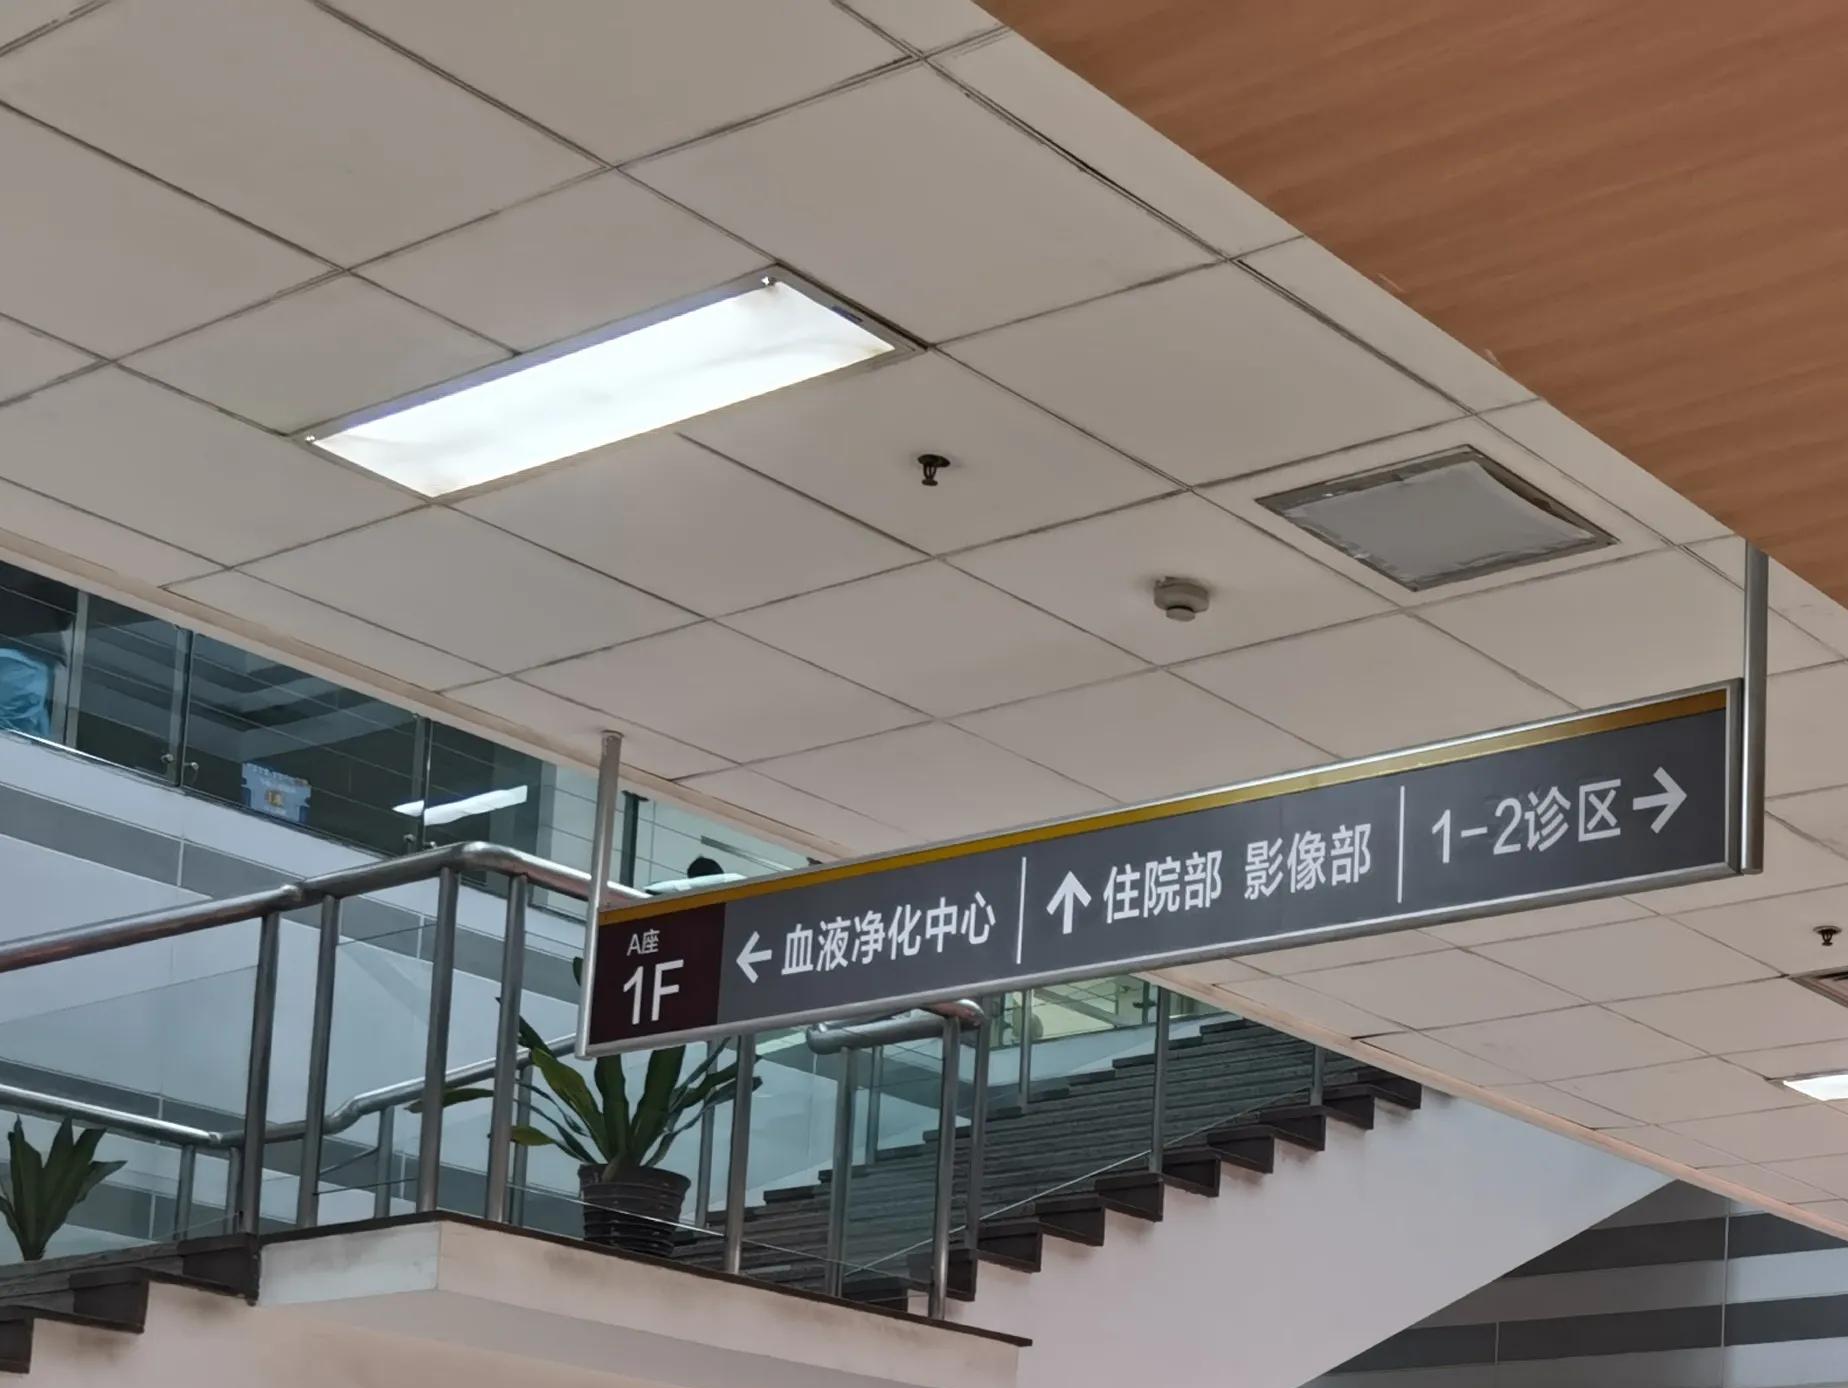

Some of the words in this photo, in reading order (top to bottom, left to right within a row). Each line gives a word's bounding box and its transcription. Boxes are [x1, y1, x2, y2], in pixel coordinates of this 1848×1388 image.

[1431, 779, 1622, 864] 1-2诊区
[1103, 850, 1222, 924] 住院部
[1244, 823, 1372, 900] 影像部
[627, 929, 661, 956] A座
[781, 892, 997, 976] 血液净化中心
[623, 959, 684, 1025] 1F
